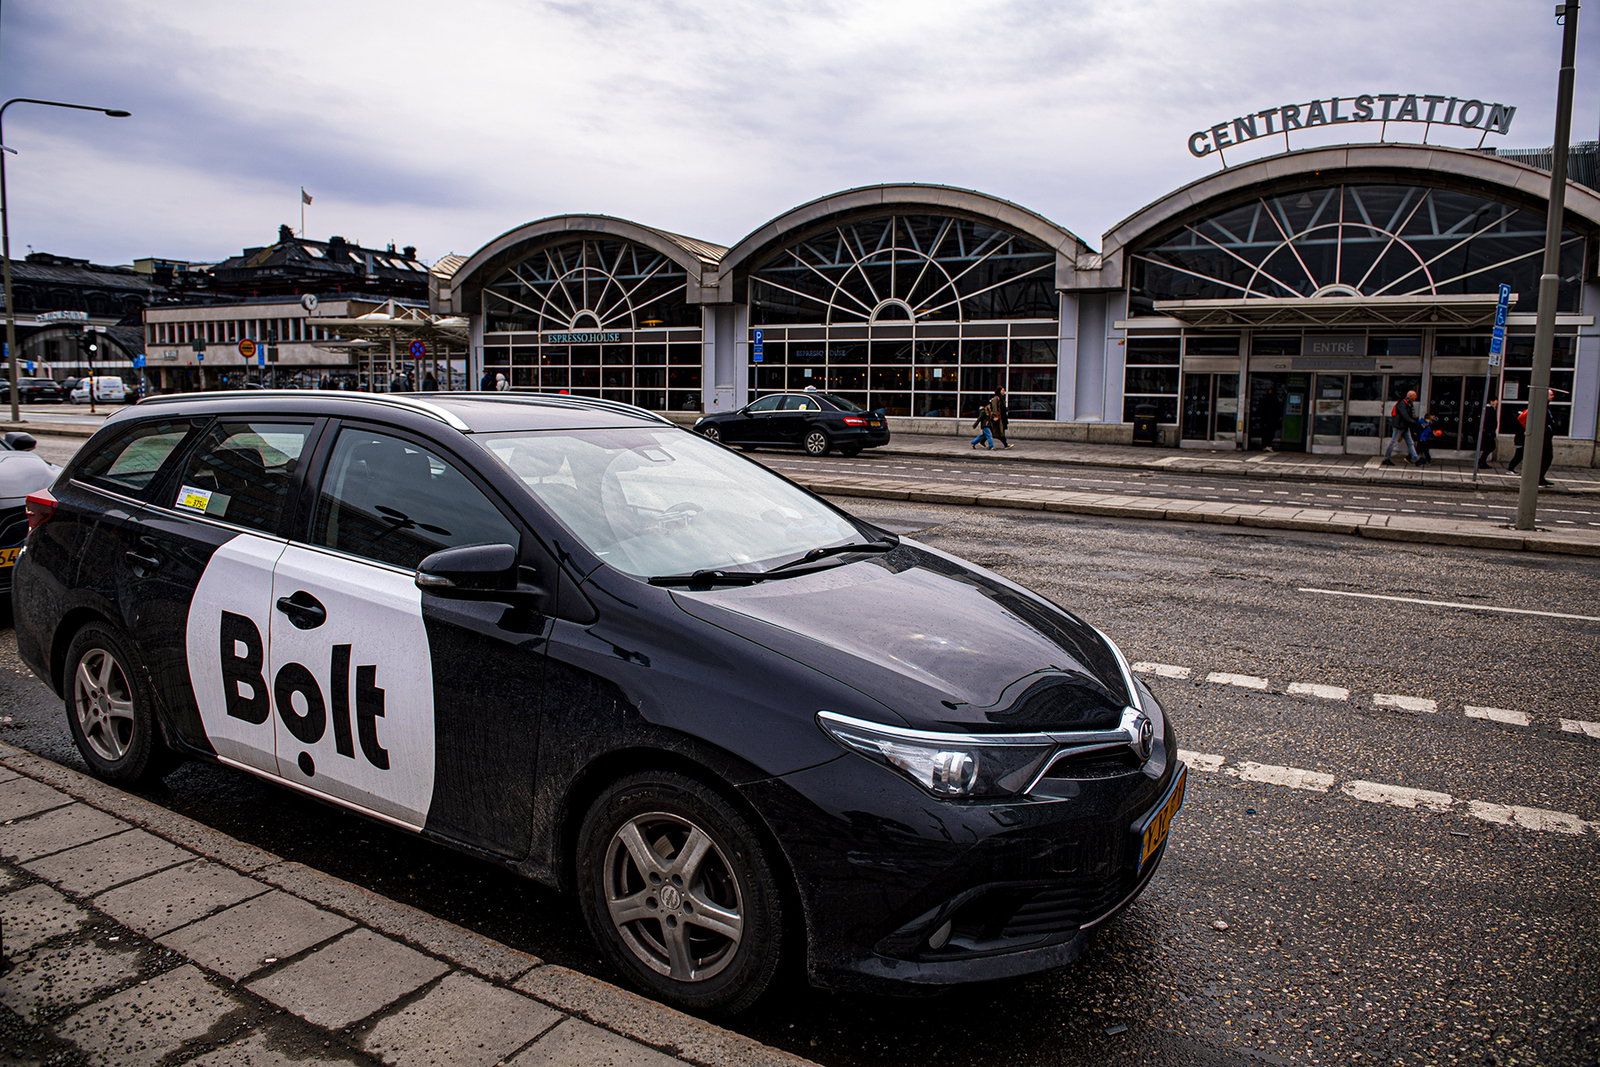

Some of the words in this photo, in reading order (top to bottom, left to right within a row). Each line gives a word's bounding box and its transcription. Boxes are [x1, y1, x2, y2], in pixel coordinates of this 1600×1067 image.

[1188, 93, 1517, 157] CENTRALSTATION
[548, 334, 588, 344] ESPRESSO
[590, 332, 621, 343] HOUSE
[755, 331, 762, 344] P
[1313, 339, 1354, 353] ENTRÉ
[221, 610, 391, 771] Bolt
